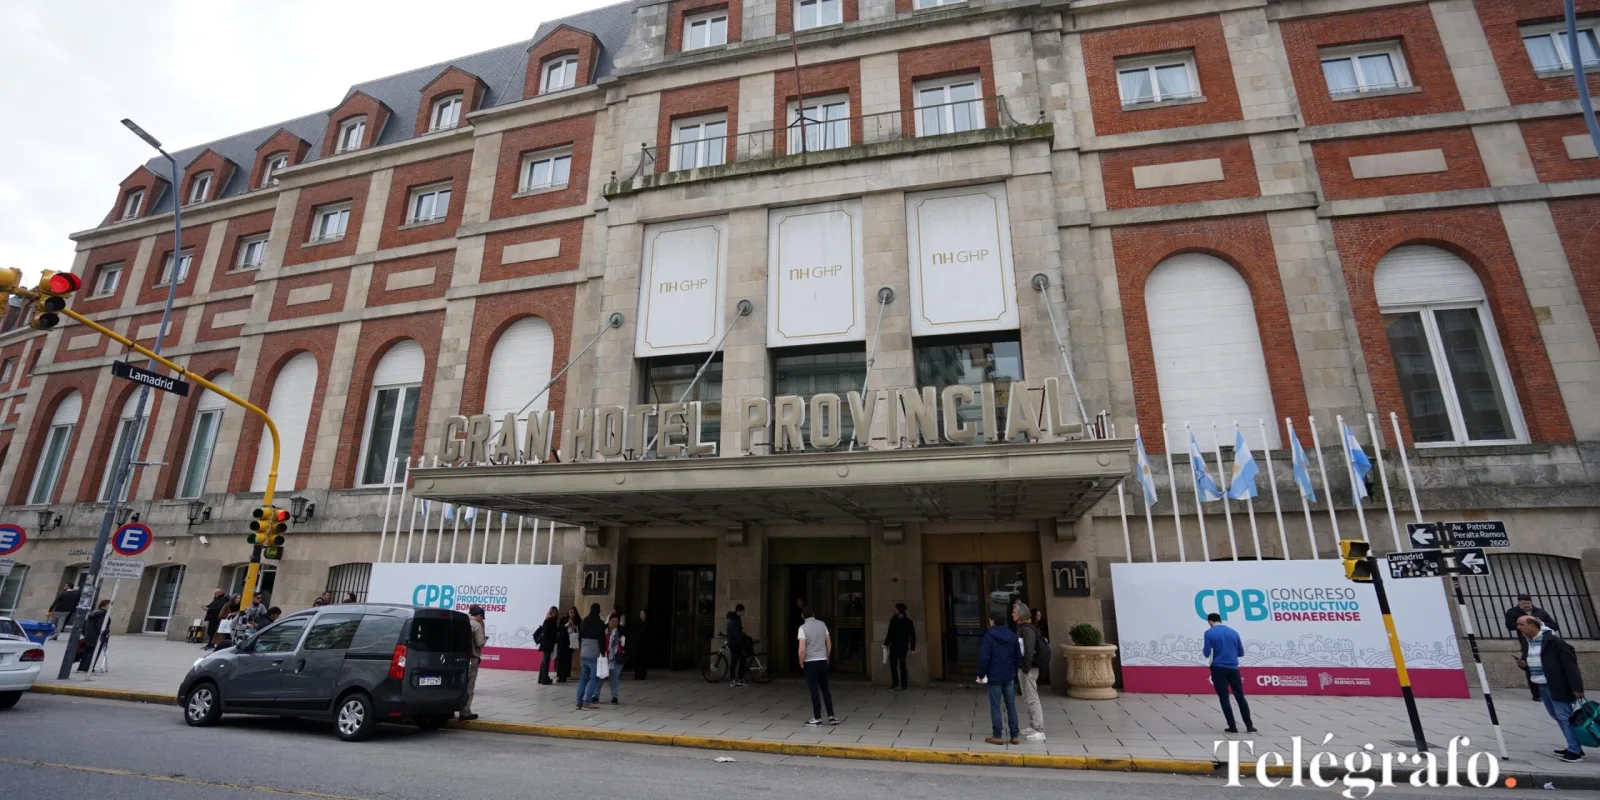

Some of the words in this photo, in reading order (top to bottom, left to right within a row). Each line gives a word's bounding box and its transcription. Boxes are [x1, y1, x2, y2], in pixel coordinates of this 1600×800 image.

[956, 248, 989, 263] GHP
[812, 264, 843, 279] GHP
[680, 278, 708, 292] GHP
[129, 368, 174, 390] Lamadrid
[440, 410, 555, 465] GRAN
[568, 401, 717, 462] HOTEL
[741, 377, 1084, 453] PROVINCIAL
[120, 529, 143, 550] E
[107, 560, 142, 568] Reservado
[1387, 552, 1424, 562] Lamadrid
[412, 584, 455, 610] CPB
[457, 585, 508, 596] CONGRESO
[1270, 587, 1356, 601] CONGRESO
[456, 595, 508, 605] PRODUCTIVO
[1194, 588, 1269, 622] CPB
[1272, 600, 1359, 611] PRODUCTIVO
[1274, 611, 1361, 622] BONAERENSE
[1256, 675, 1280, 686] CPB
